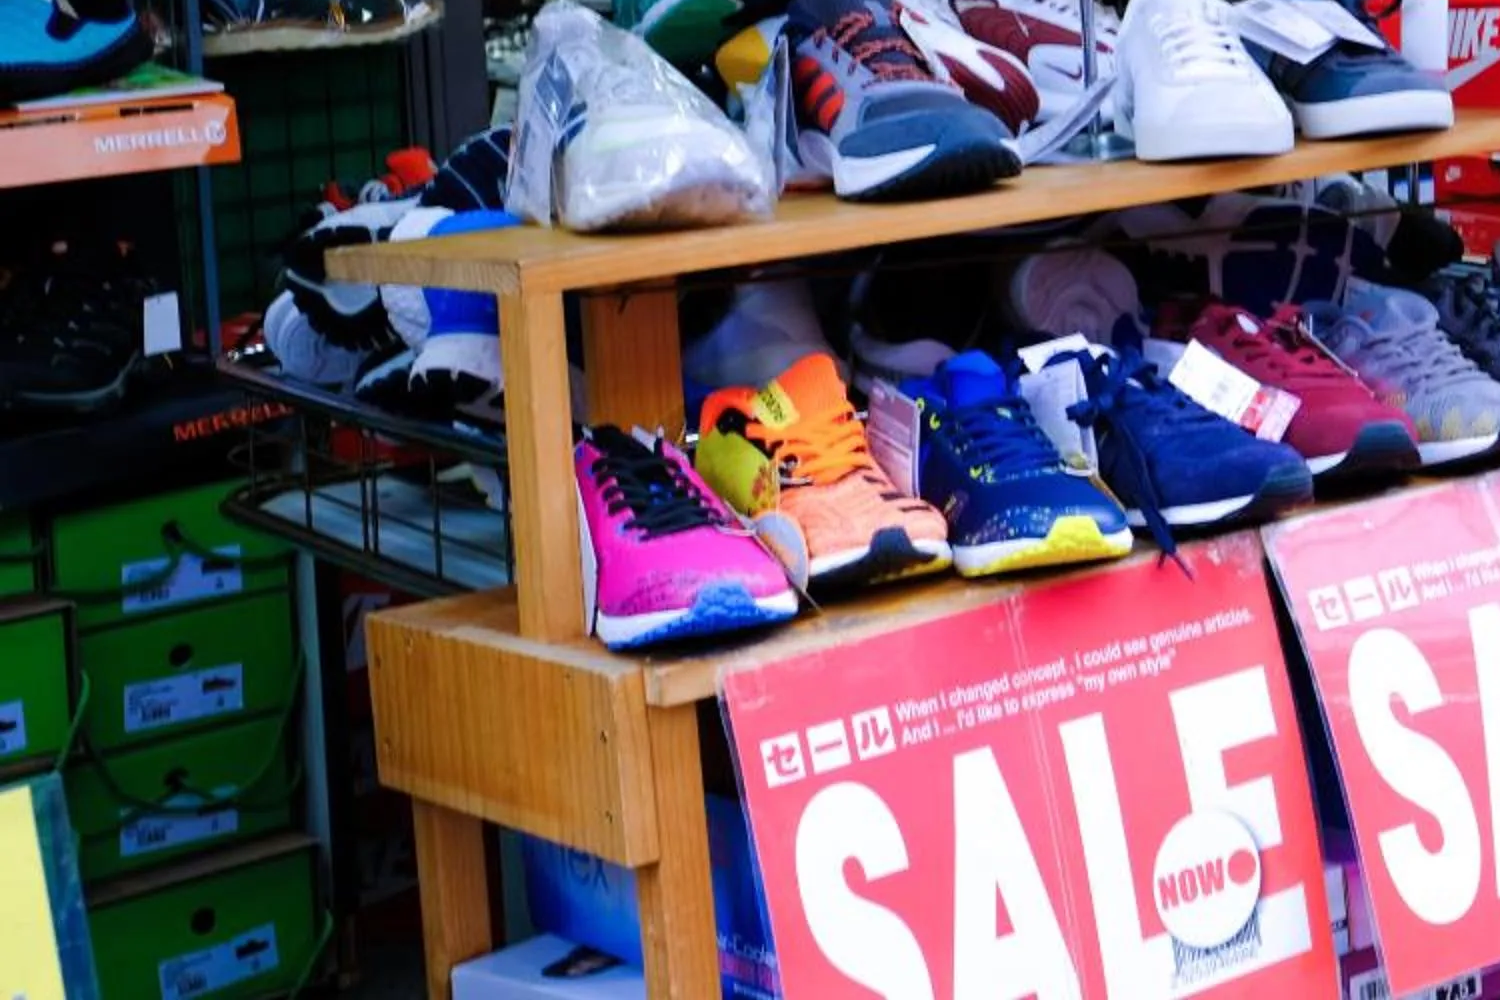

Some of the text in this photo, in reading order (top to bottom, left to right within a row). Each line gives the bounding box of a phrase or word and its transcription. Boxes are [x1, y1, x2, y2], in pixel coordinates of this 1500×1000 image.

[1314, 573, 1410, 622] セール
[896, 697, 938, 721] When
[949, 675, 1010, 708] changed
[1083, 641, 1121, 669] could
[1149, 622, 1203, 654] genuine
[1203, 607, 1255, 637] articles.
[901, 721, 932, 747] And
[975, 700, 1005, 724] like
[1006, 697, 1020, 717] to
[1107, 665, 1138, 687] own
[766, 716, 891, 777] セール
[795, 667, 1312, 1000] SALE
[1158, 857, 1224, 911] NOW
